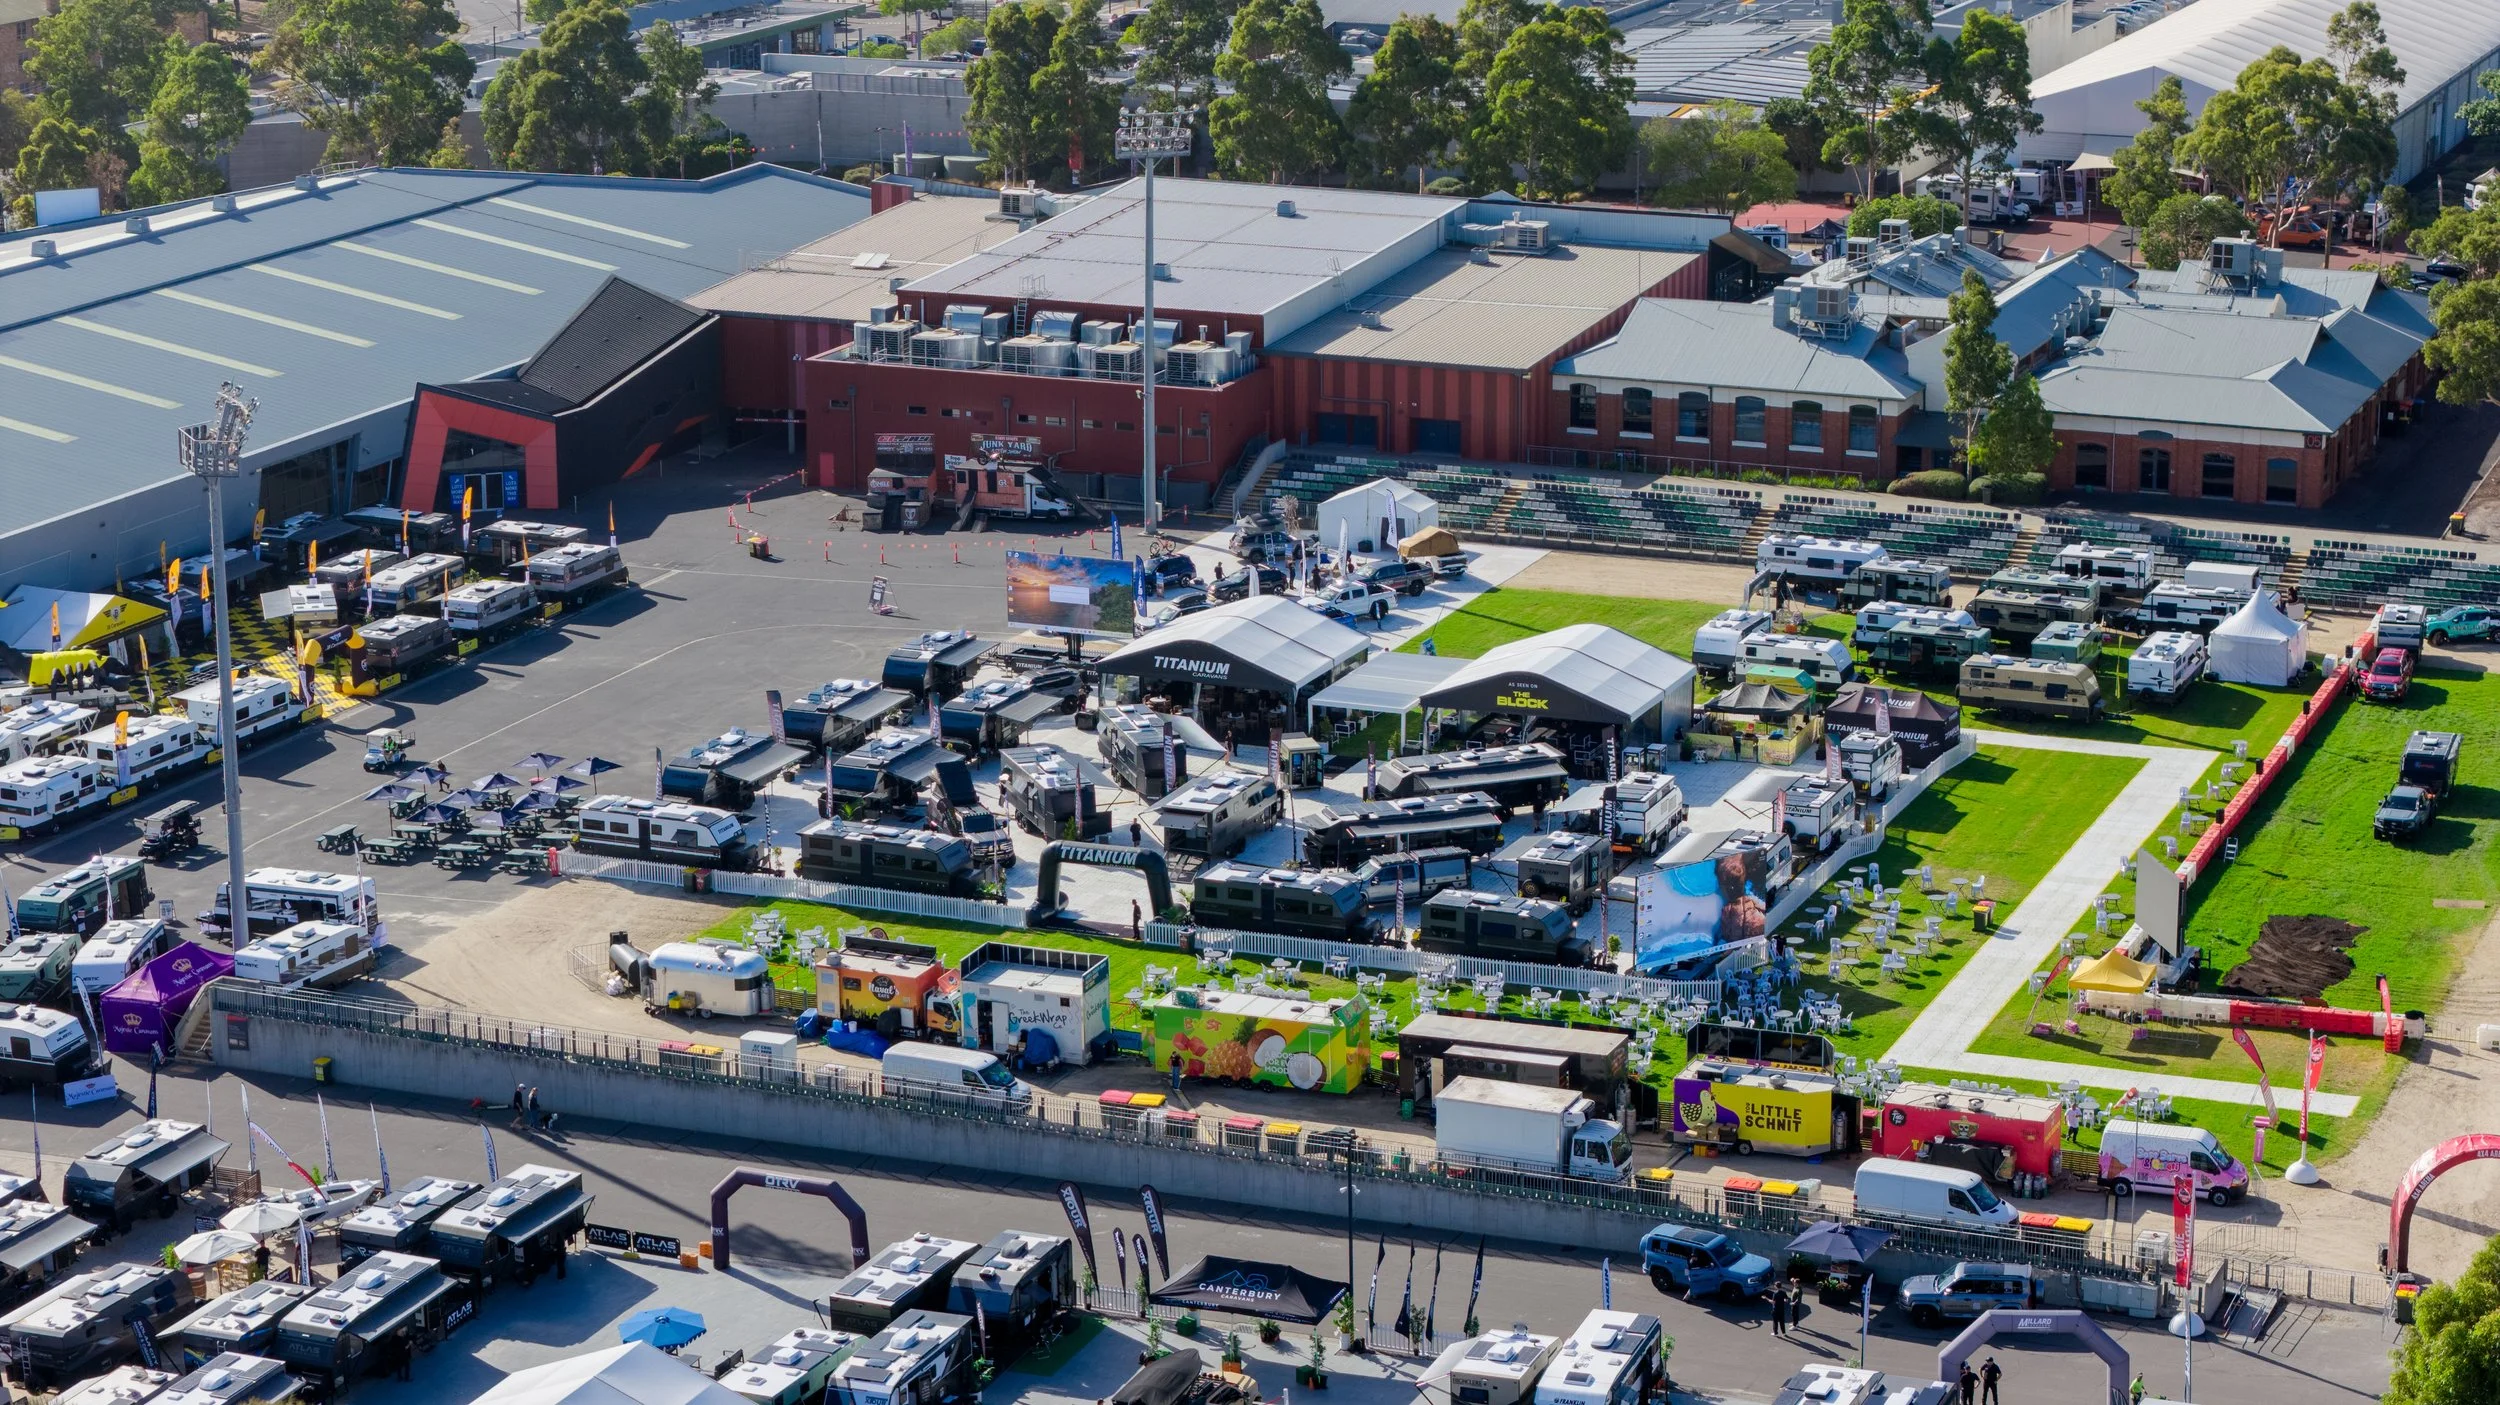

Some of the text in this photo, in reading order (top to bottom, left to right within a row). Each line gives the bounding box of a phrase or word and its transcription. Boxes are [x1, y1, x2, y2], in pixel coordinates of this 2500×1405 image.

[981, 440, 1033, 453] JUNK YARD
[2307, 435, 2321, 448] 05
[1154, 655, 1230, 675] TITANIUM
[1192, 672, 1228, 680] CARAVANS
[1496, 695, 1549, 710] BLOCK
[1865, 697, 1916, 710] TINIUM
[1061, 846, 1138, 865] TITANIUM
[1528, 868, 1559, 876] TITANIUM
[1264, 1058, 1280, 1066] FOR
[1264, 1066, 1289, 1075] MOOD
[1751, 1103, 1802, 1120] LITTLE
[1745, 1115, 1802, 1132] SCHNIT
[765, 1175, 800, 1189] OTRV
[2420, 1173, 2436, 1191] ARENA
[1061, 1186, 1087, 1228] XTOUR
[1141, 1190, 1163, 1234] XTOUR
[588, 1236, 628, 1246] CARAVANS
[589, 1228, 628, 1241] ATLAS
[636, 1244, 677, 1254] CARAVANS
[637, 1236, 676, 1250] ATLAS
[1199, 1282, 1282, 1301] CANTERBURY
[1220, 1294, 1255, 1302] CARAVANS
[447, 1301, 472, 1325] ATLAS
[844, 1318, 878, 1328] ATLAS
[2018, 1318, 2052, 1327] MILLARD
[138, 1320, 151, 1347] SOLAR
[289, 1343, 321, 1354] ATLAS
